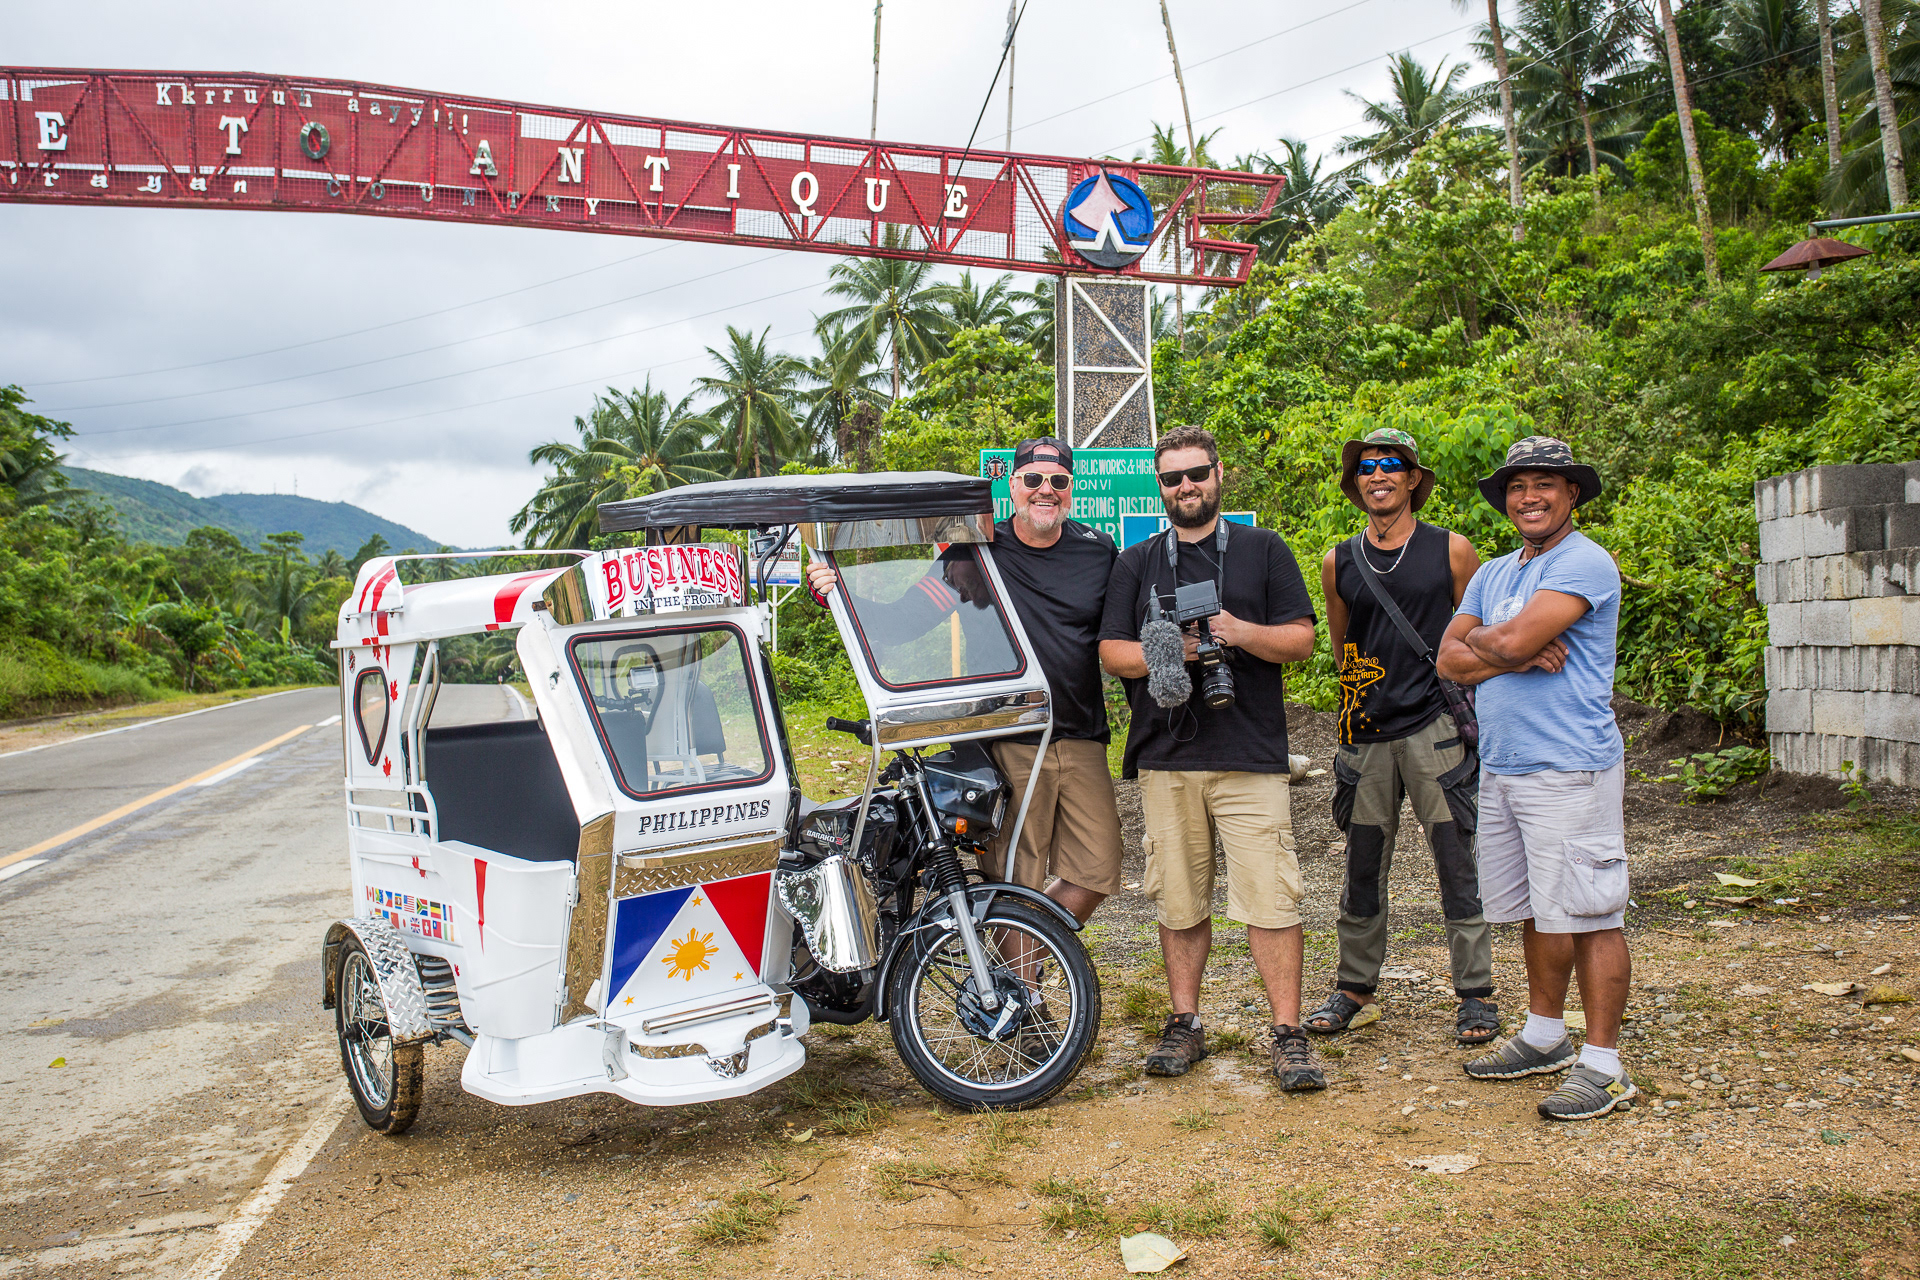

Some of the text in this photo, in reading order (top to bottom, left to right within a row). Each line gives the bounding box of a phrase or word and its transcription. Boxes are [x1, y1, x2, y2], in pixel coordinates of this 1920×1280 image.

[218, 114, 331, 160] TO
[469, 139, 968, 220] ANTIQUE
[326, 178, 600, 216] COUNTRY
[1099, 459, 1126, 475] WORKS
[1127, 459, 1136, 475] &
[1136, 459, 1156, 475] HIGH
[1073, 479, 1111, 491] ION VI
[602, 547, 741, 610] BUSINESS
[634, 593, 723, 610] IN THE FRONT
[638, 799, 771, 835] PHILIPPINES
[806, 829, 835, 843] BARAKO
